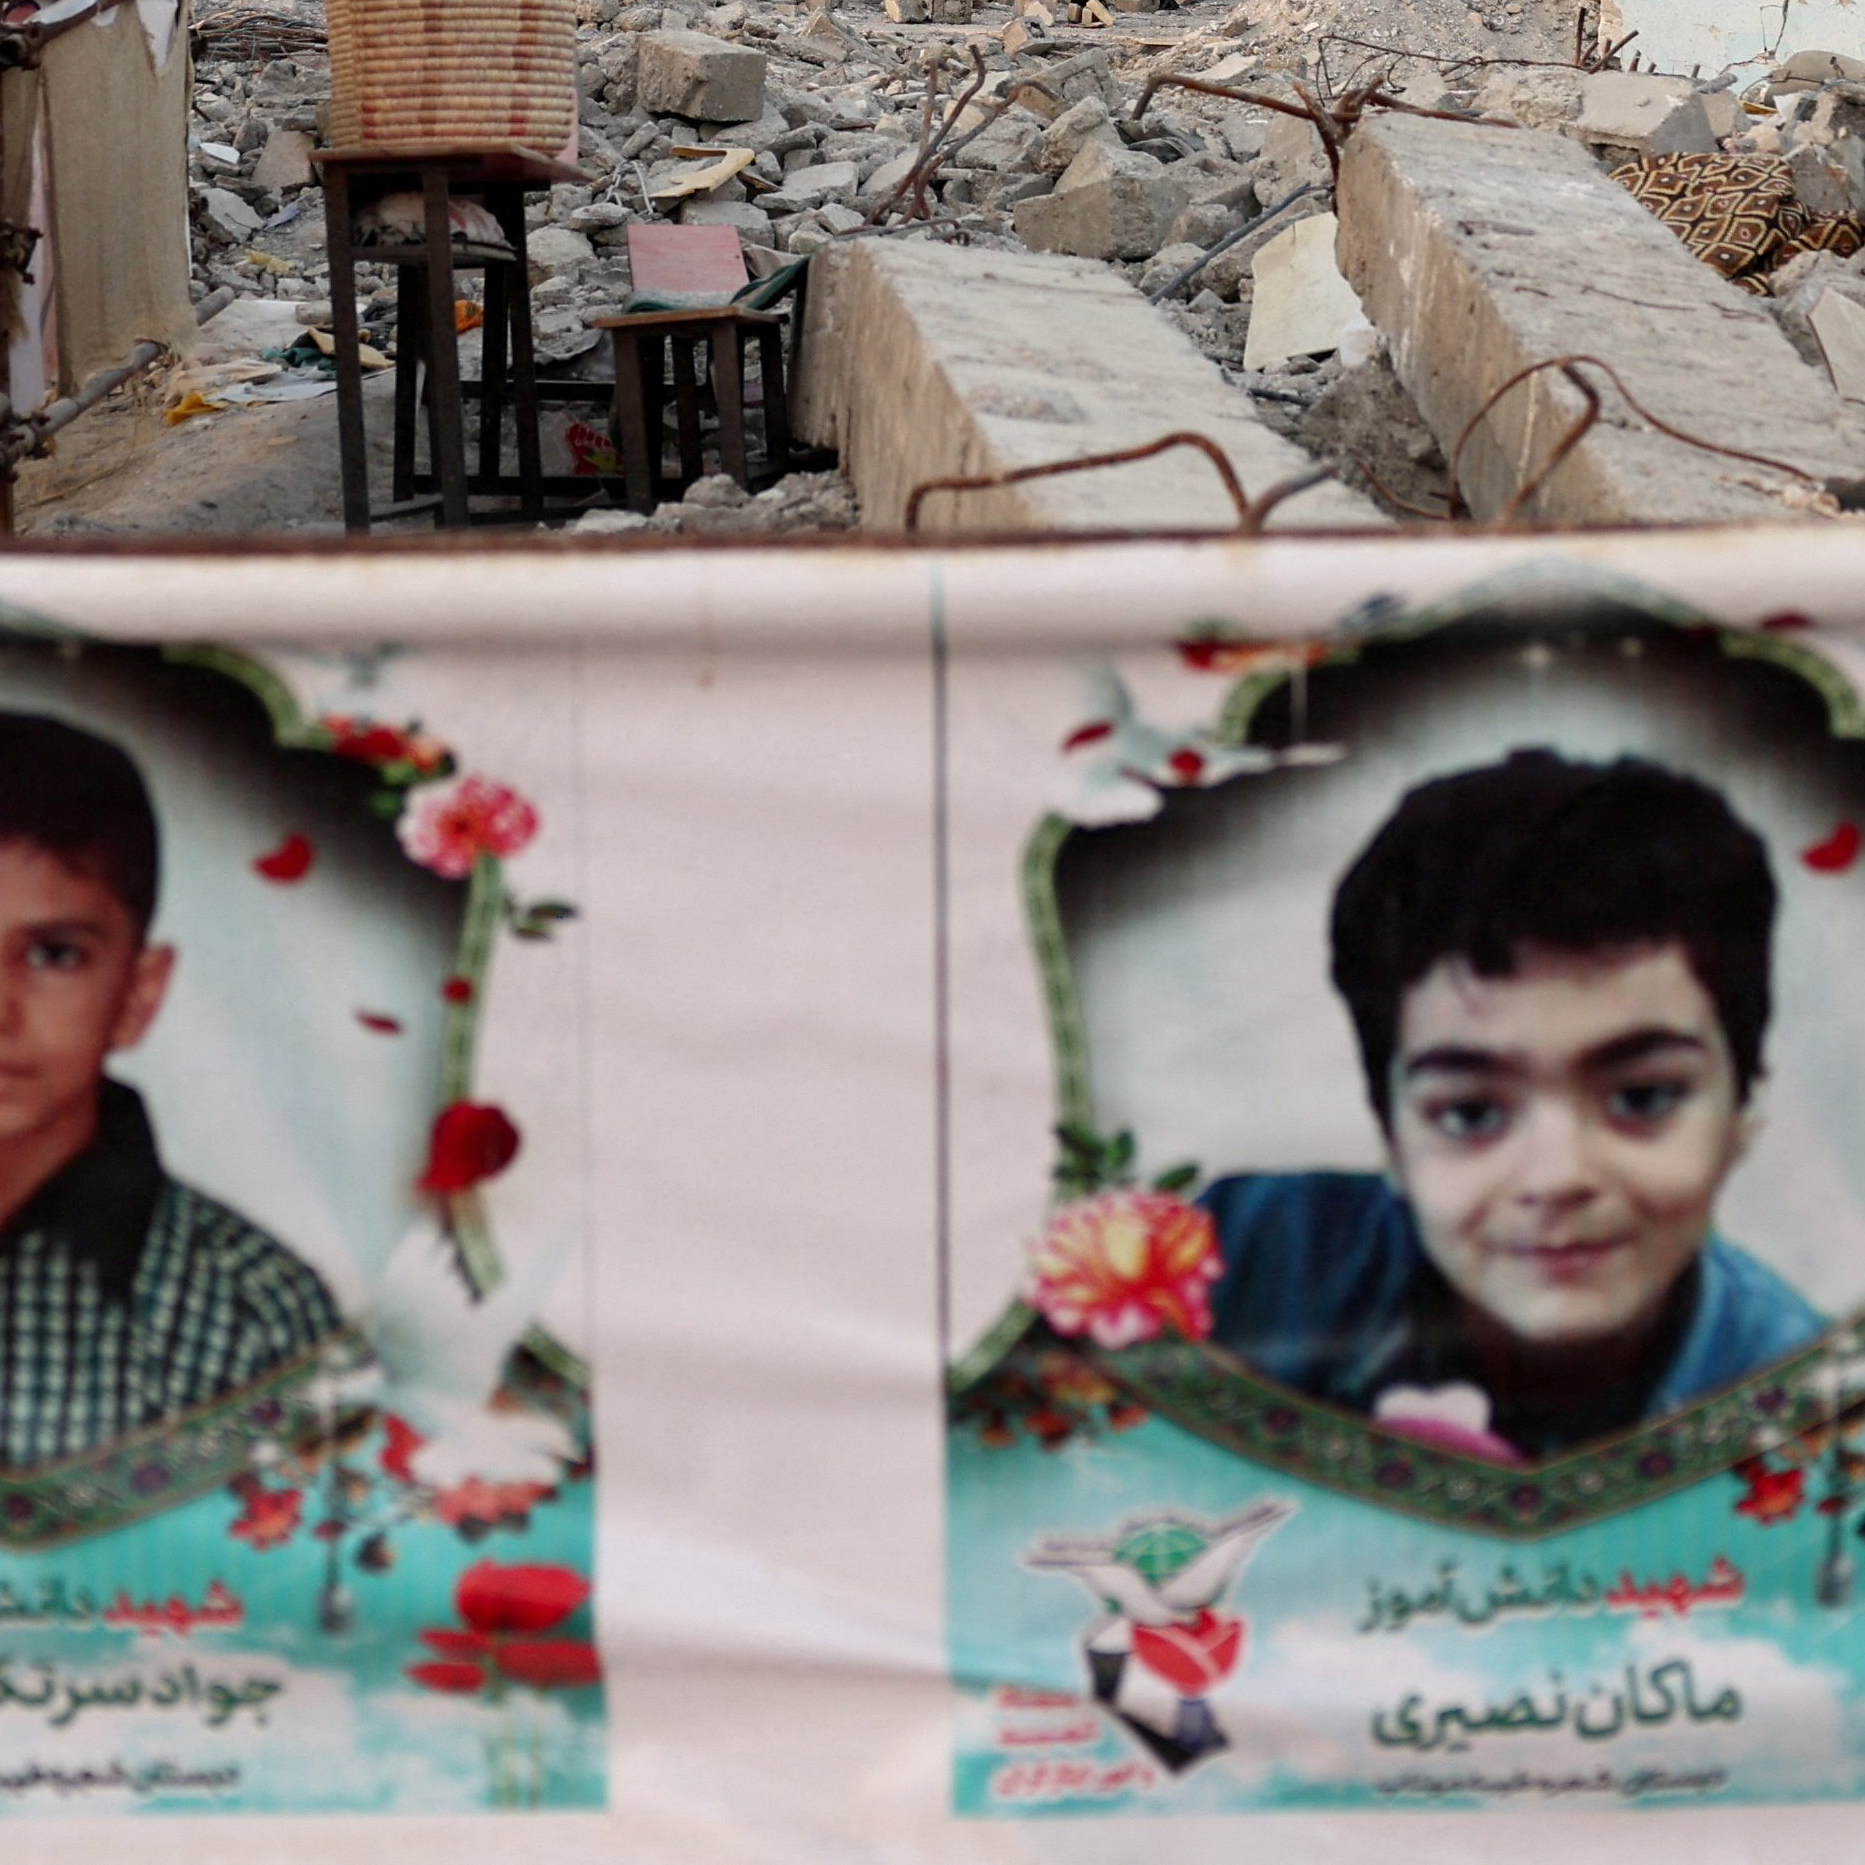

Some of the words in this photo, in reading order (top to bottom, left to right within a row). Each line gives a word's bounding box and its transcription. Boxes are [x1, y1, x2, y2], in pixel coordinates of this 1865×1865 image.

[103, 1578, 243, 1639] شهید
[1605, 1556, 1745, 1619] شهید
[152, 1662, 282, 1727] جواد
[1371, 1669, 1568, 1752] نصیری
[1575, 1656, 1741, 1741] ماکان
